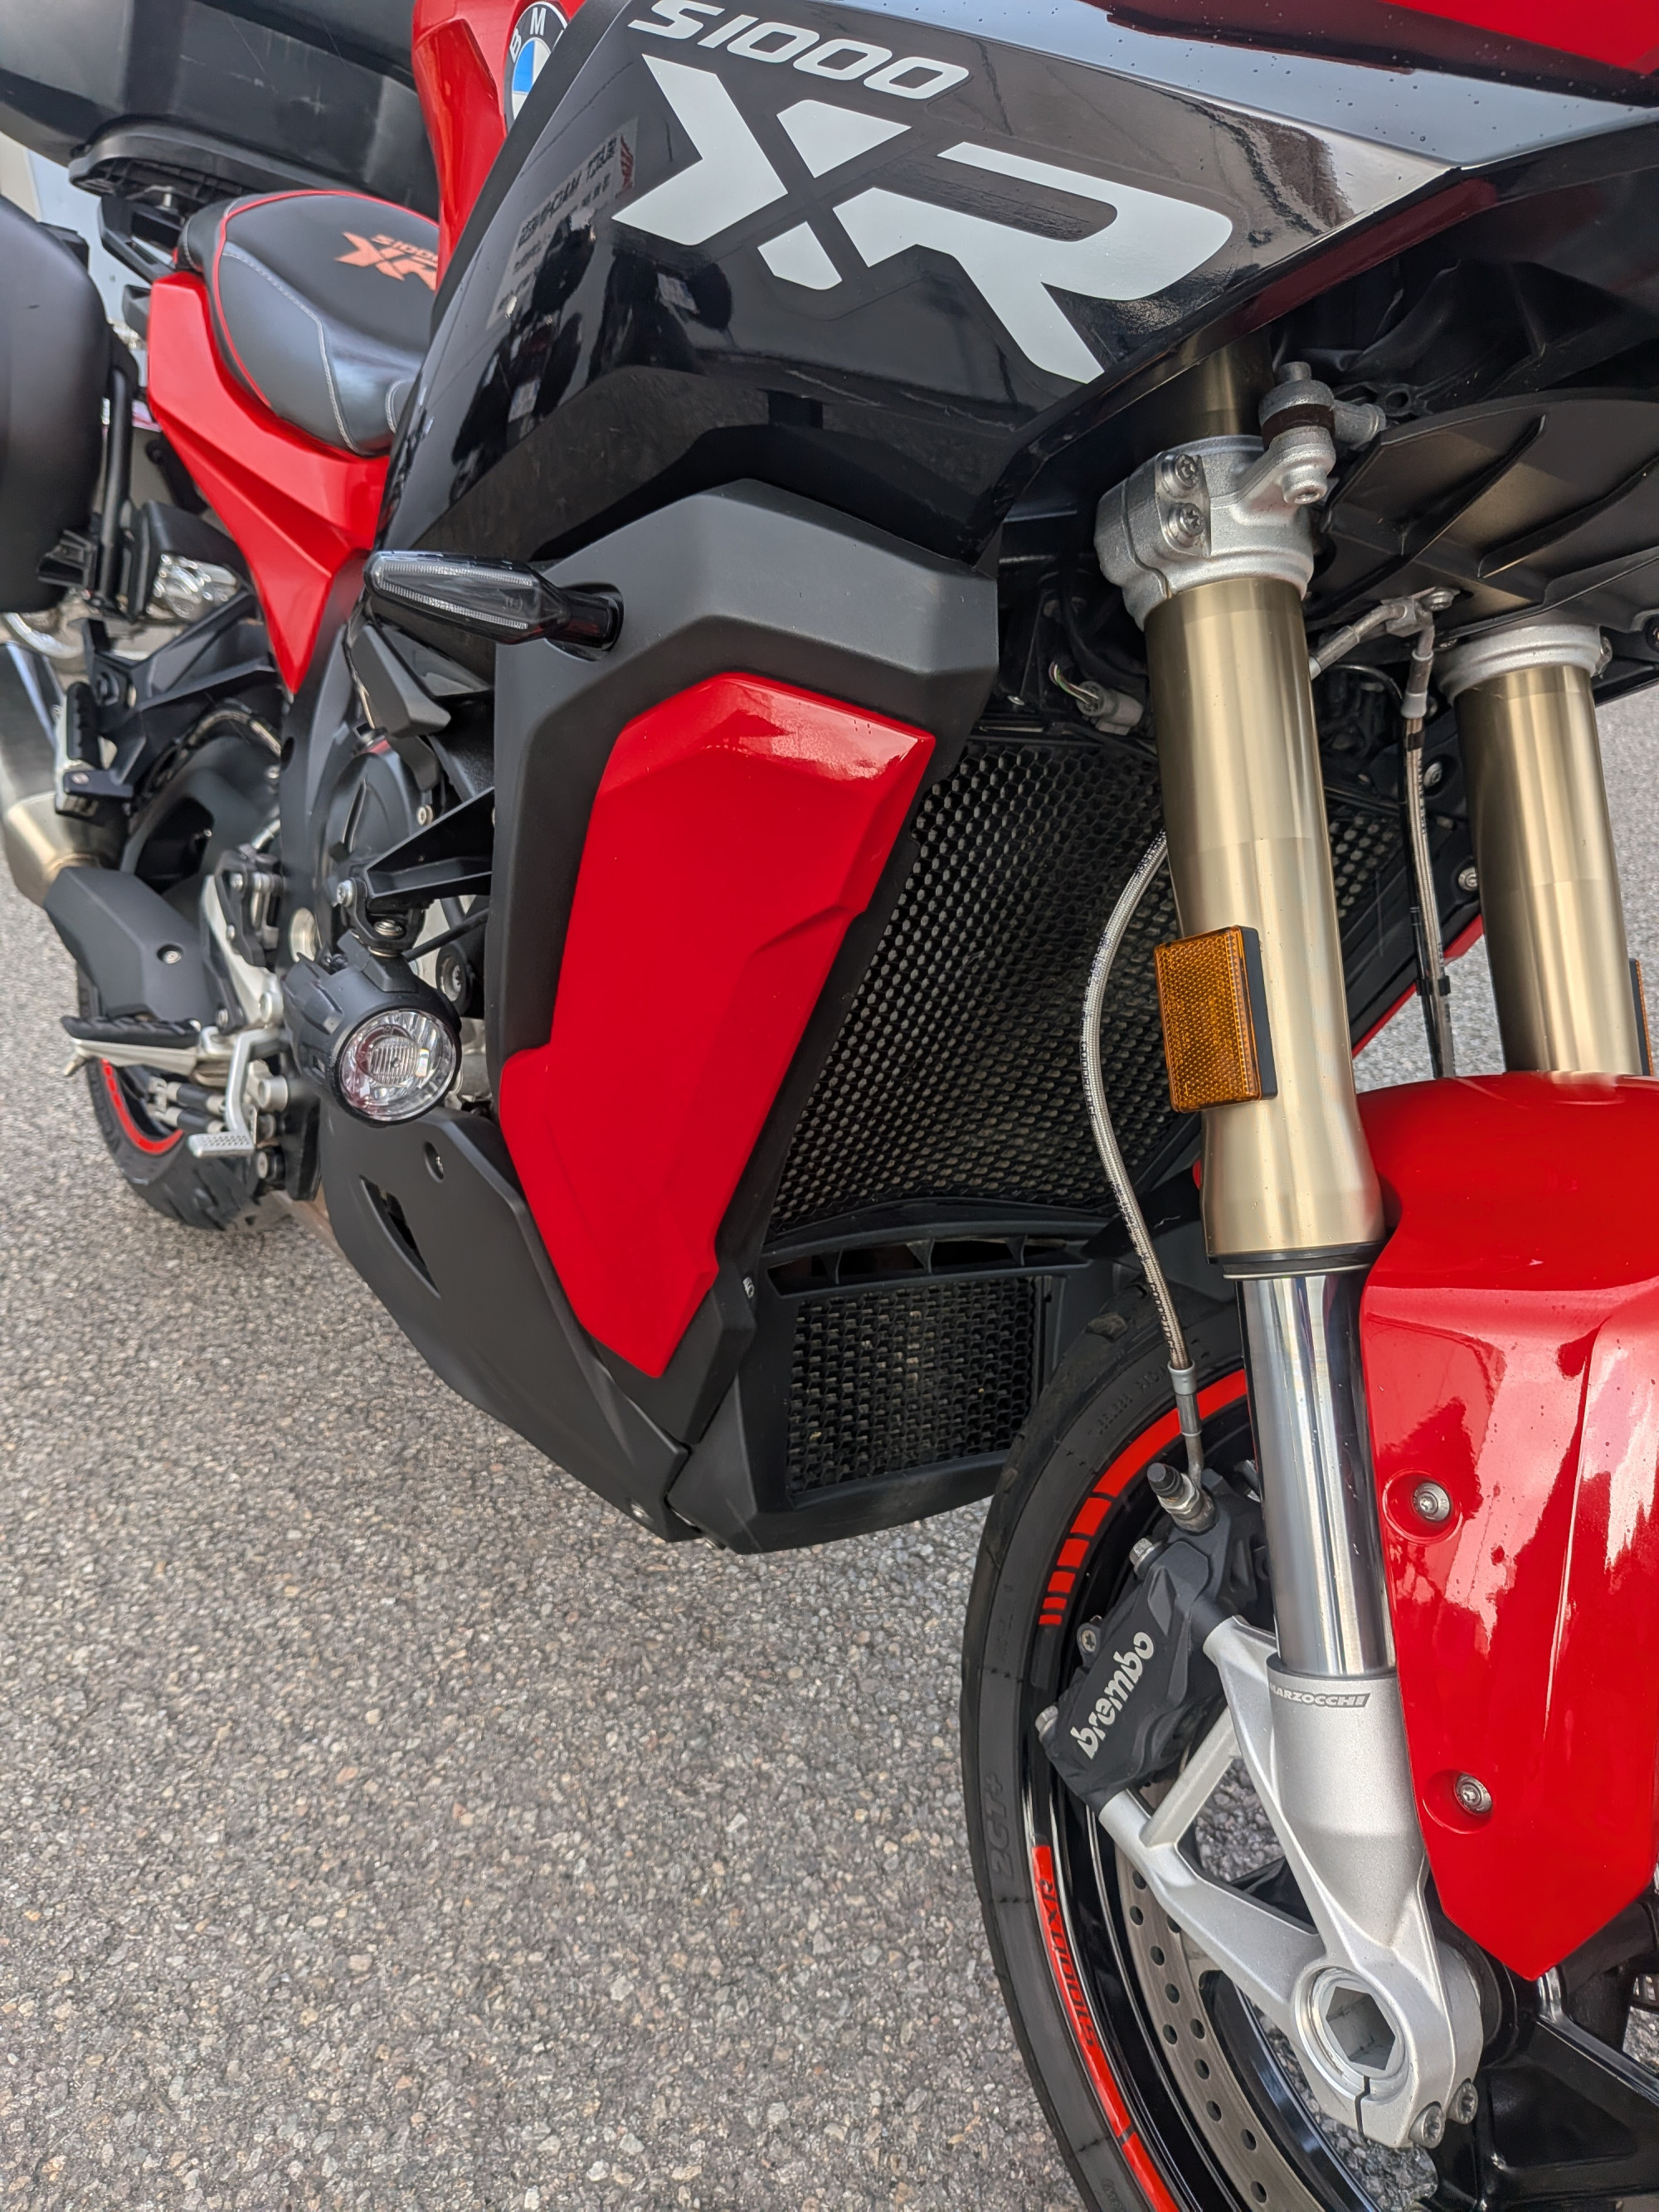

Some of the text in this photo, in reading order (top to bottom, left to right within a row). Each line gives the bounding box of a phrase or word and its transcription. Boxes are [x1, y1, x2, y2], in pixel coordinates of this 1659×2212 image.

[509, 7, 564, 64] BM
[627, 0, 970, 100] S1000
[611, 53, 1233, 385] XR
[1069, 1631, 1155, 1760] brembo
[1269, 1682, 1367, 1707] MARZOCCHI
